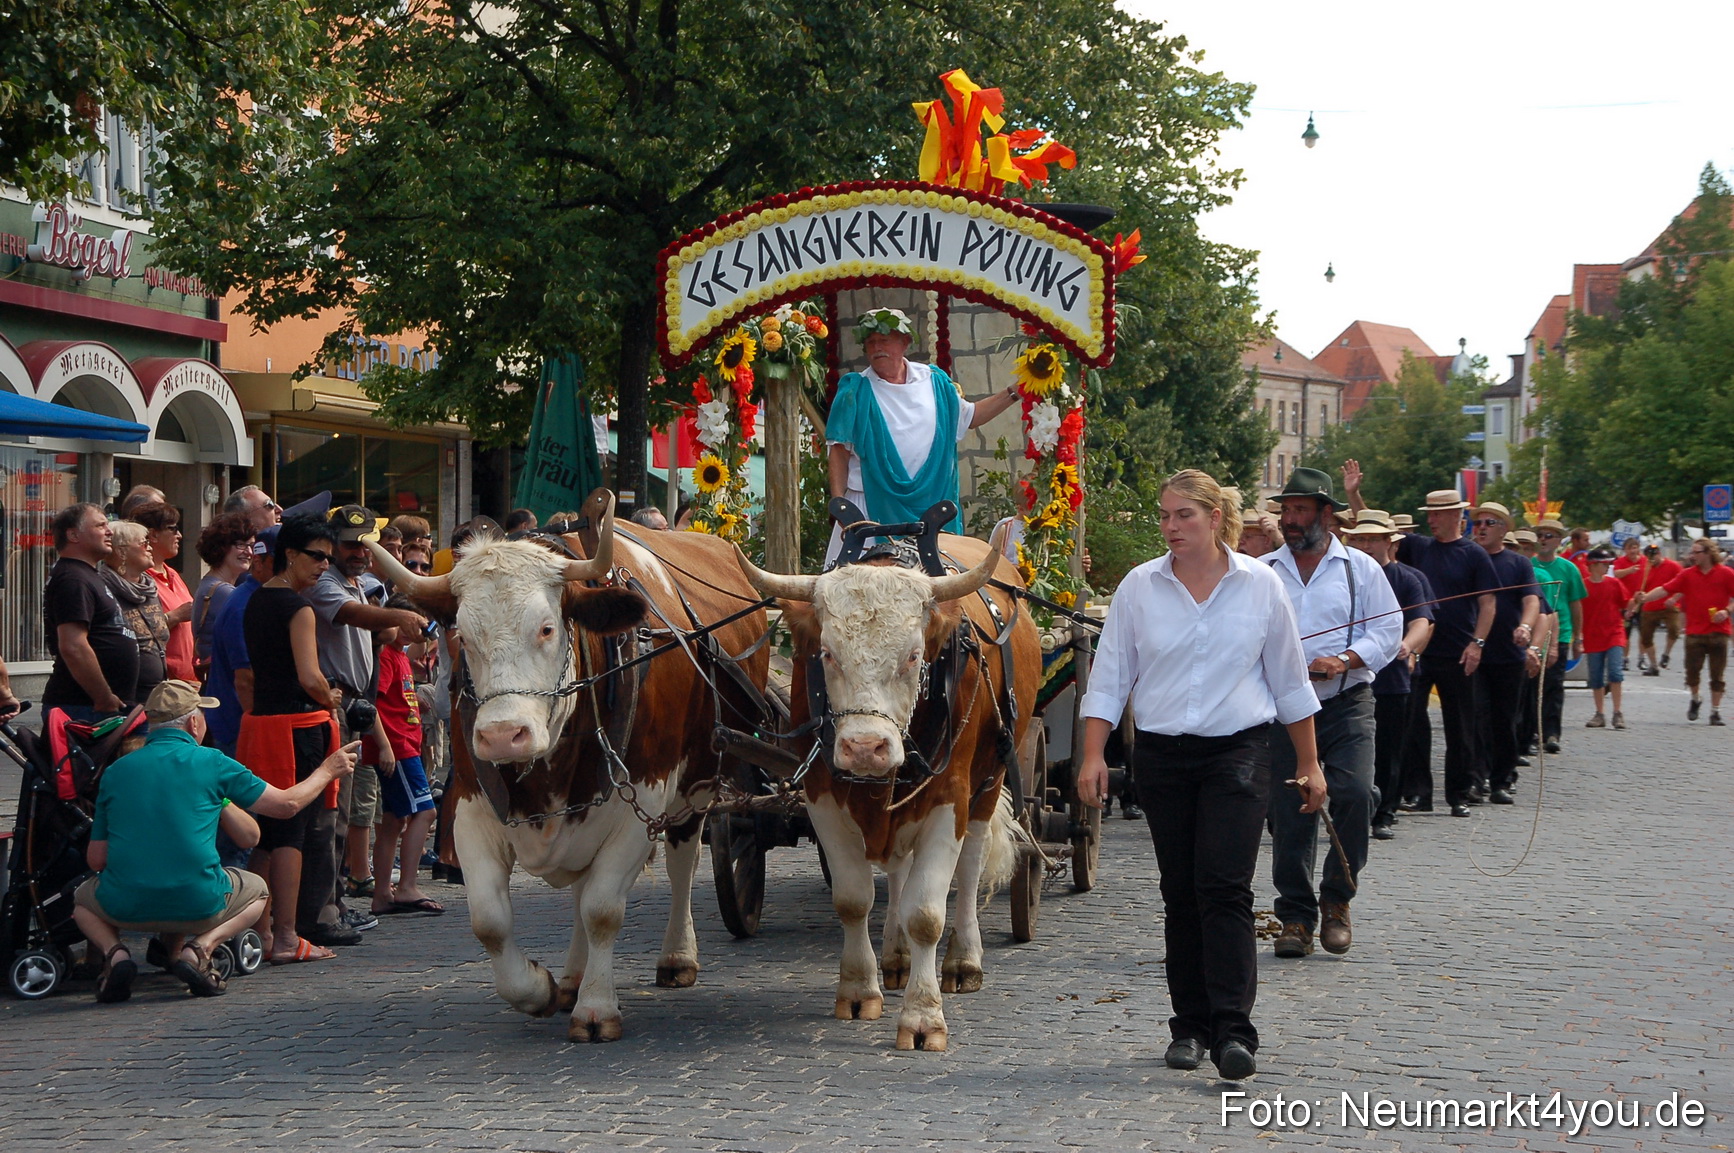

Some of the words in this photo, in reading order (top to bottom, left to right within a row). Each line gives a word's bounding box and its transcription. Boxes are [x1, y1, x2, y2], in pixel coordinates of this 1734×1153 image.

[0, 231, 27, 258] EREI
[42, 202, 134, 281] Bögerl
[143, 265, 160, 289] AM
[686, 209, 943, 309] GESANGVEREIN
[958, 218, 1087, 312] PÖLLING
[60, 349, 125, 385] Metzgerei
